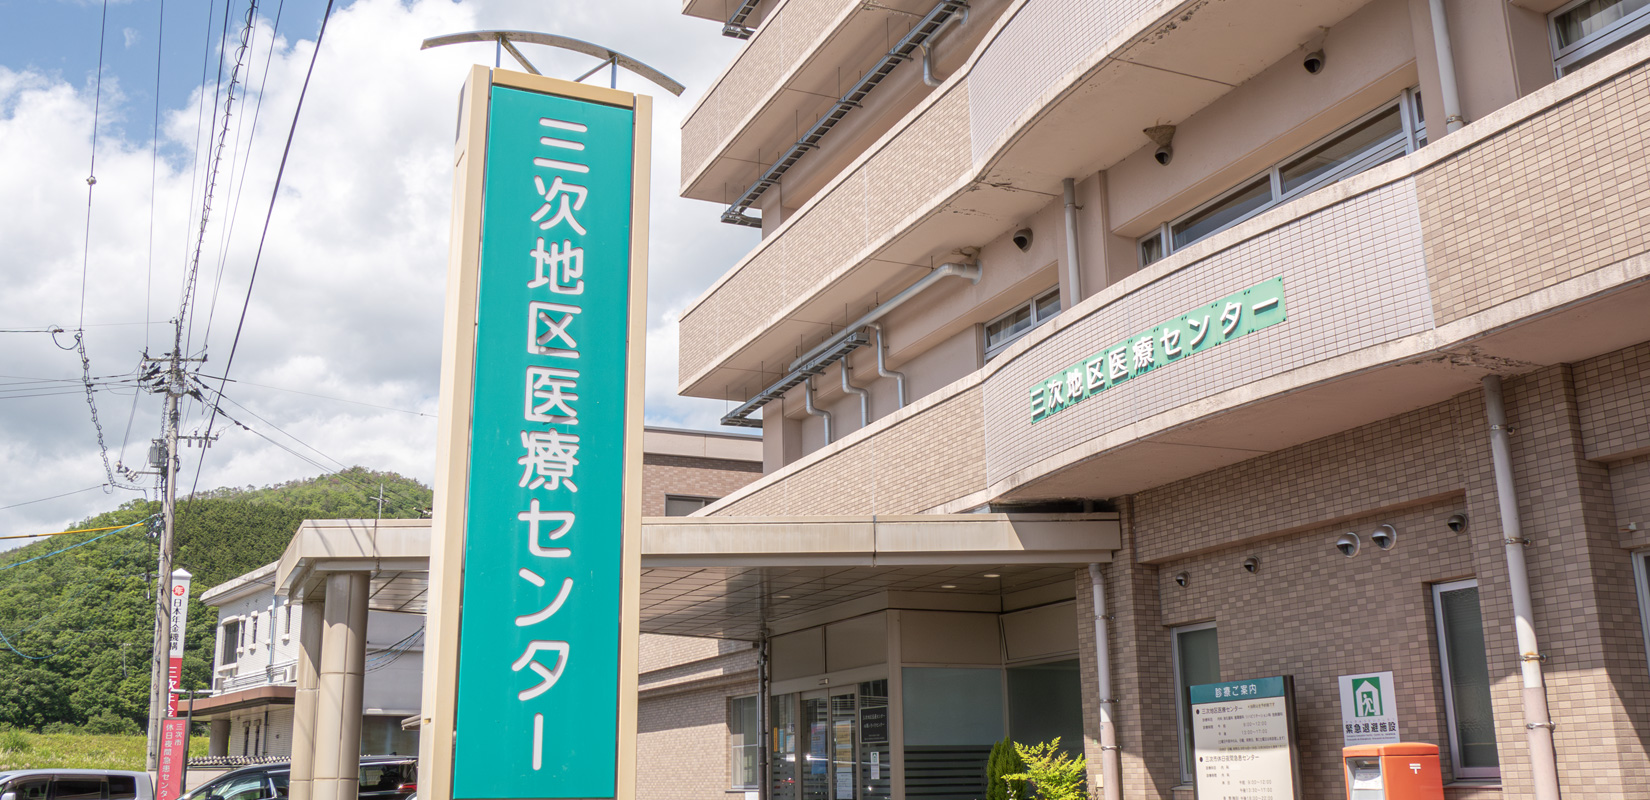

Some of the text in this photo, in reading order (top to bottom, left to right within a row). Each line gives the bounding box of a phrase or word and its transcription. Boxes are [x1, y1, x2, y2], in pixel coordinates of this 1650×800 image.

[1030, 296, 1279, 418] 三次地区医療センター
[511, 117, 590, 771] 三次地区医療センター
[1215, 684, 1257, 698] 診療ご案内
[1201, 705, 1243, 715] 三次地区医療センター
[174, 723, 183, 746] 三次市
[1346, 722, 1396, 733] 緊急退避施設
[161, 724, 174, 800] 休日夜間急患センタ
